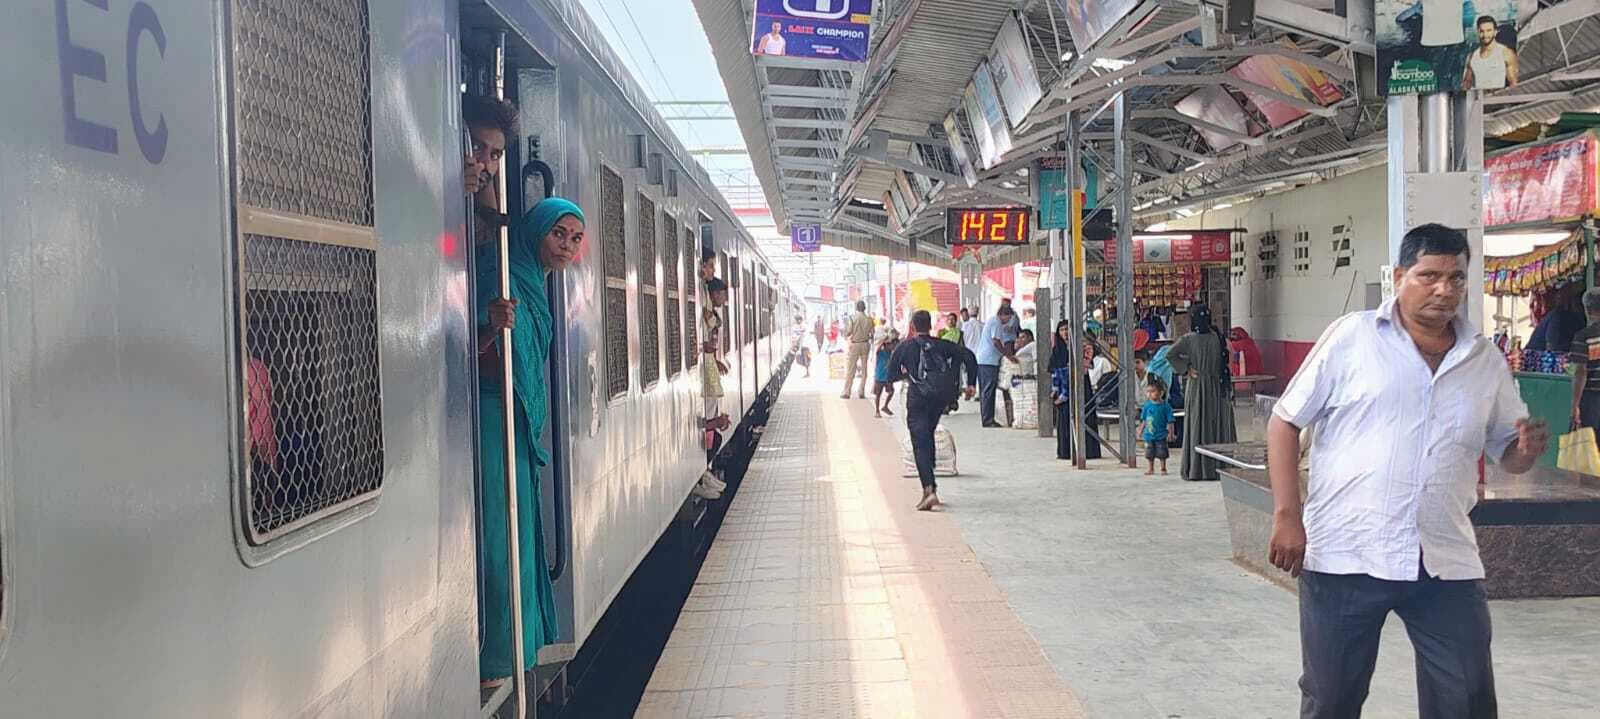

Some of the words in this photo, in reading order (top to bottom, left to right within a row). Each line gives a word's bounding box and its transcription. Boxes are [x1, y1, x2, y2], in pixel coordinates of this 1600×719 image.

[816, 27, 864, 39] CHAMPION
[55, 0, 168, 165] EC
[1418, 84, 1435, 92] VEST
[961, 213, 1025, 241] 1421
